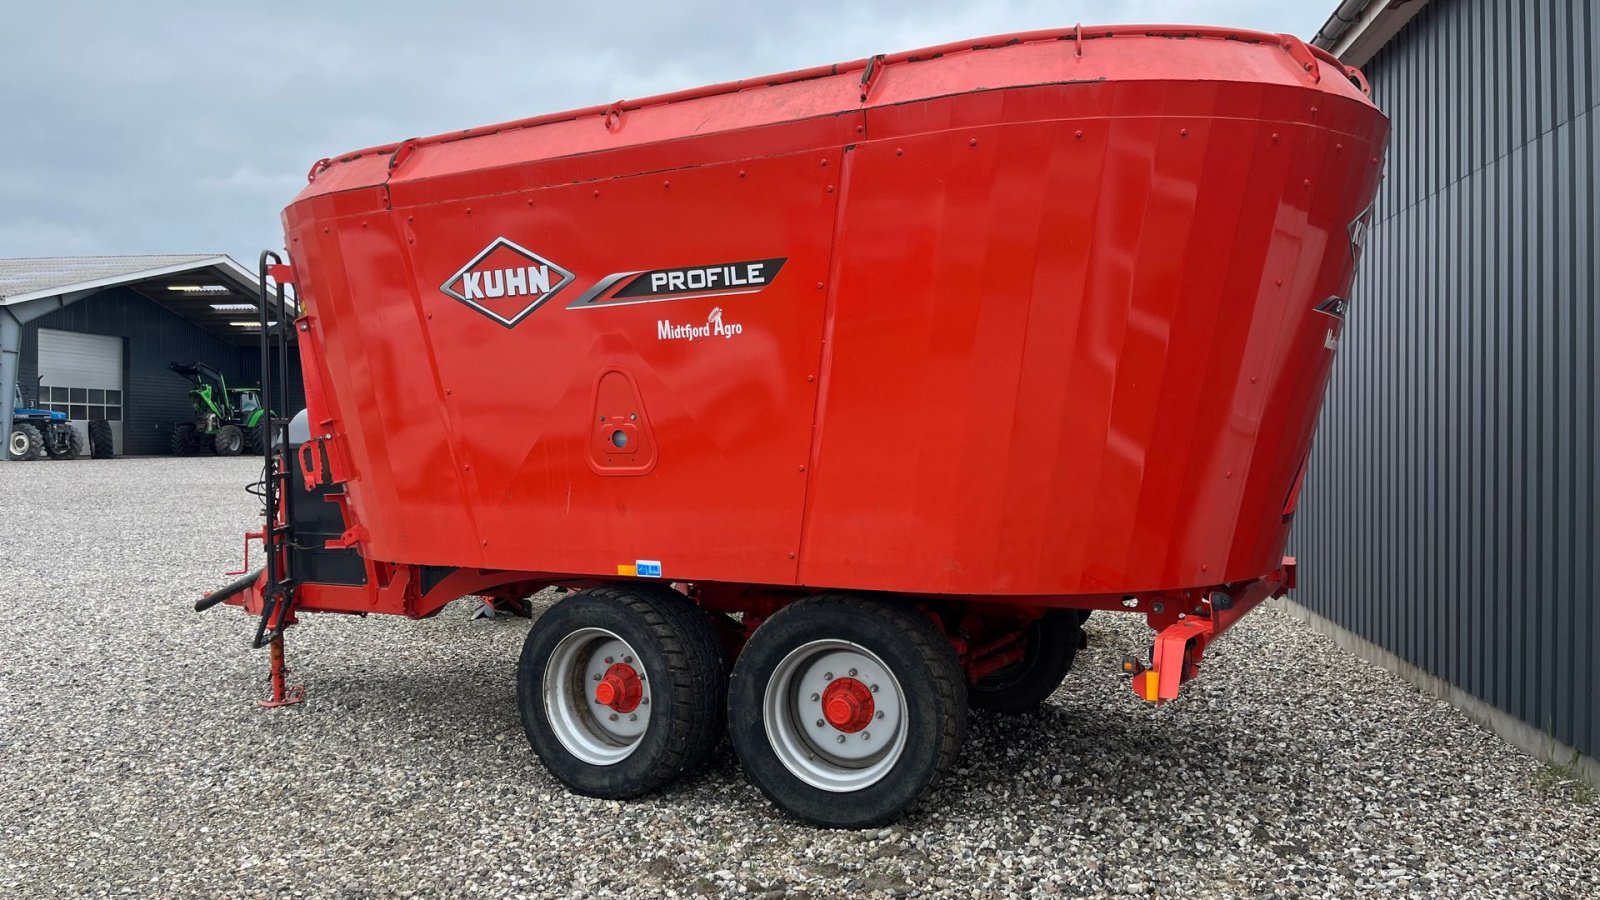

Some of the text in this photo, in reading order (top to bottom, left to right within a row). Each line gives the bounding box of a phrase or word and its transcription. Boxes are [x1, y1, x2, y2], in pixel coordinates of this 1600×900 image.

[462, 265, 551, 300] KUHN
[651, 263, 766, 292] PROFILE
[657, 315, 743, 341] Midtfjord Agro
[29, 400, 35, 408] 3
